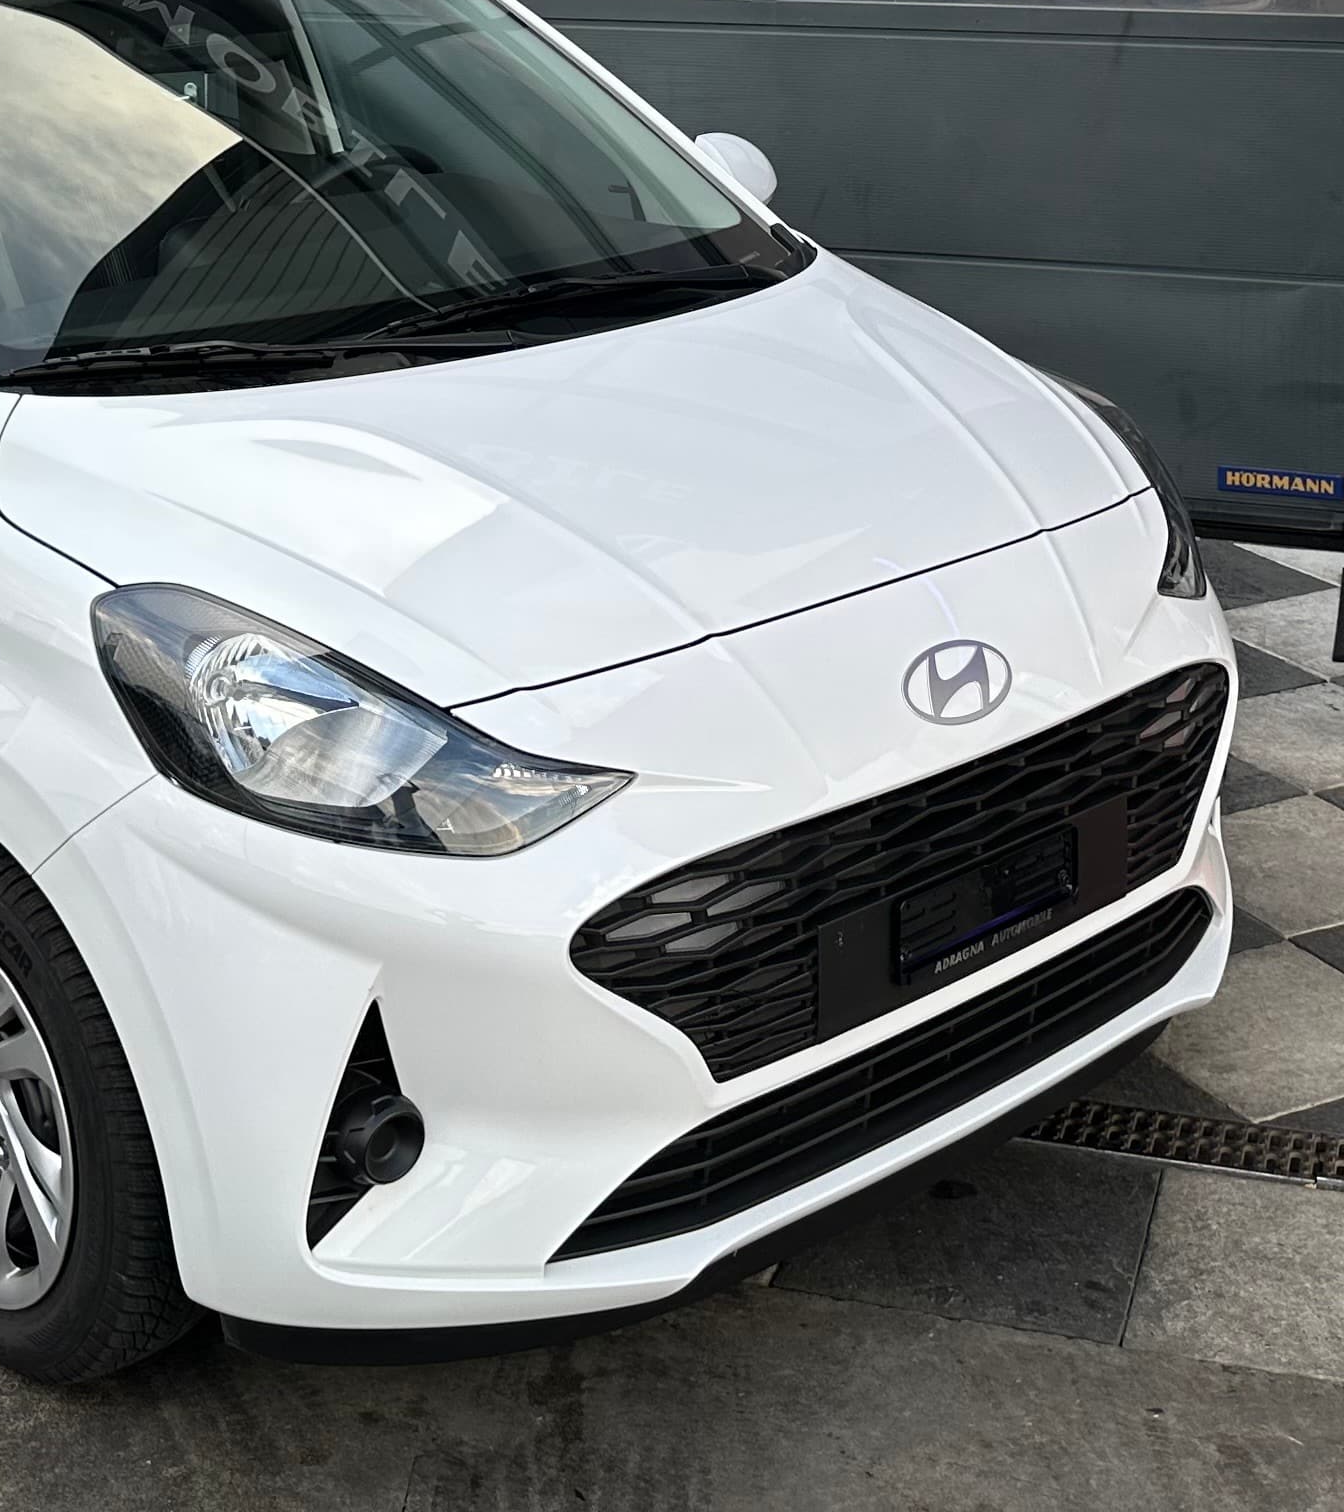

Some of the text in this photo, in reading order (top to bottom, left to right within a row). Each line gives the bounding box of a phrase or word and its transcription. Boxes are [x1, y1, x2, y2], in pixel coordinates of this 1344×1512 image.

[1226, 470, 1334, 495] HÖRMANN
[934, 907, 1053, 974] ADRAGNA AUTOMOBILE
